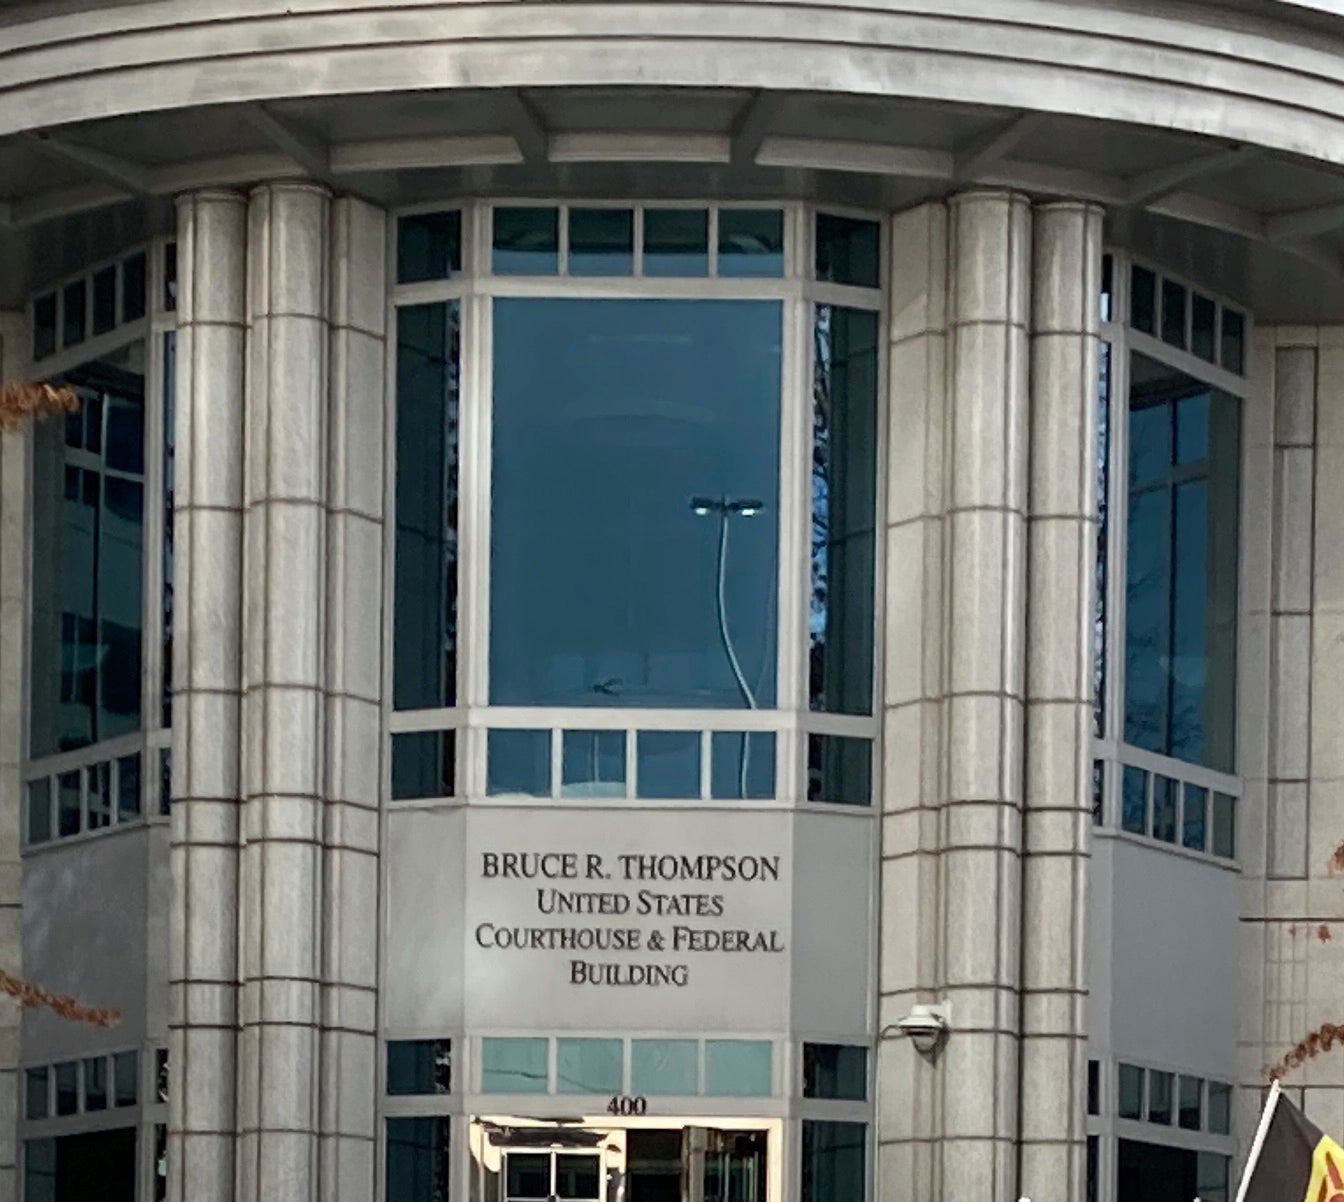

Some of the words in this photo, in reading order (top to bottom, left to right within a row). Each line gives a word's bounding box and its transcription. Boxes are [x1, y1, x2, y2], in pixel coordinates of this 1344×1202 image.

[481, 852, 577, 879] BRUCE
[585, 854, 611, 880] R.
[618, 855, 781, 881] THOMPSON
[537, 888, 630, 914] UNITED
[637, 890, 723, 916] STATES
[476, 923, 641, 950] COURTHOUSE
[647, 930, 665, 951] &
[672, 926, 784, 952] FEDERAL
[569, 960, 688, 986] BUILDING
[607, 1096, 647, 1116] 400
